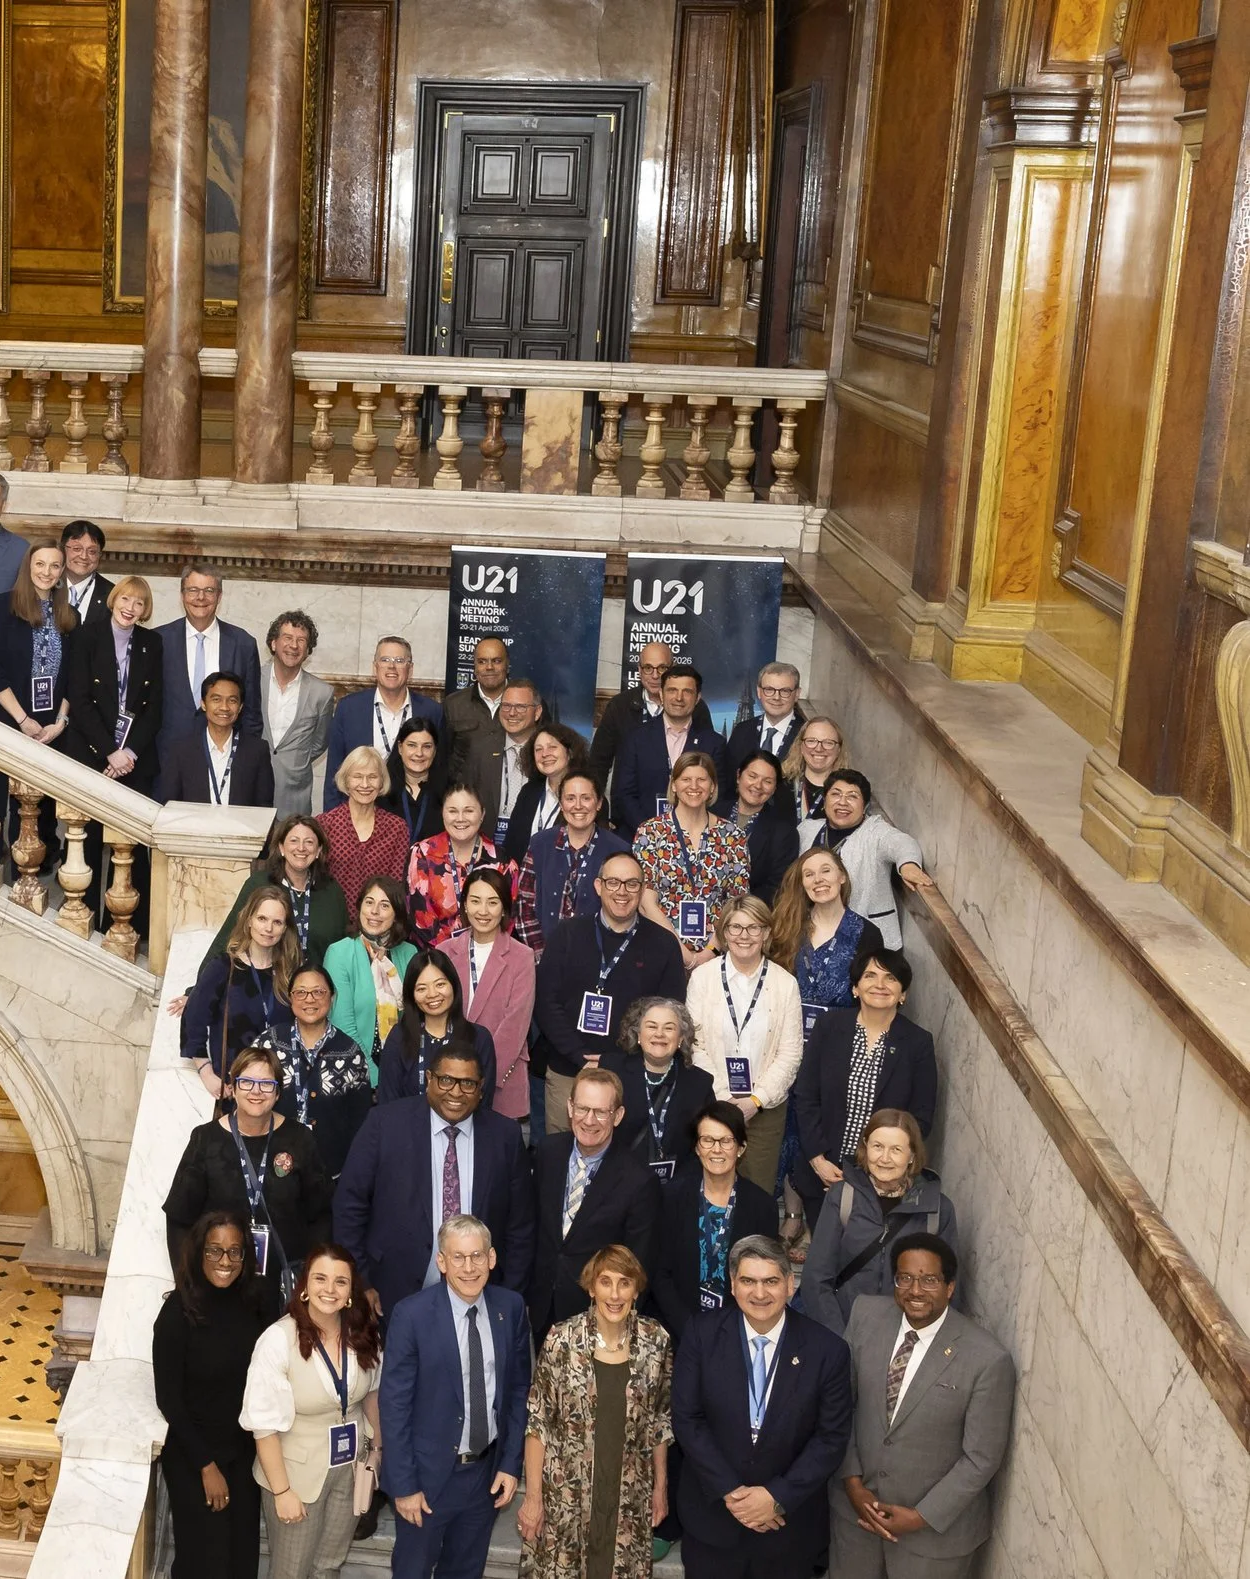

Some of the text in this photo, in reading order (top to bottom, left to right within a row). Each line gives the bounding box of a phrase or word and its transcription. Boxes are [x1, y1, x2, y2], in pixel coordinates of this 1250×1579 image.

[462, 564, 518, 594] U21
[632, 578, 704, 616] U21
[461, 598, 499, 608] ANNUAL
[460, 606, 506, 616] NETWORK
[460, 614, 500, 624] MEETING
[460, 623, 477, 631] 20-21
[478, 624, 493, 632] April
[631, 622, 679, 633] ANNUAL
[630, 632, 688, 644] NETWORK
[37, 682, 48, 690] U21
[590, 999, 604, 1009] U21
[730, 1061, 745, 1070] U21
[700, 1294, 715, 1307] U21
